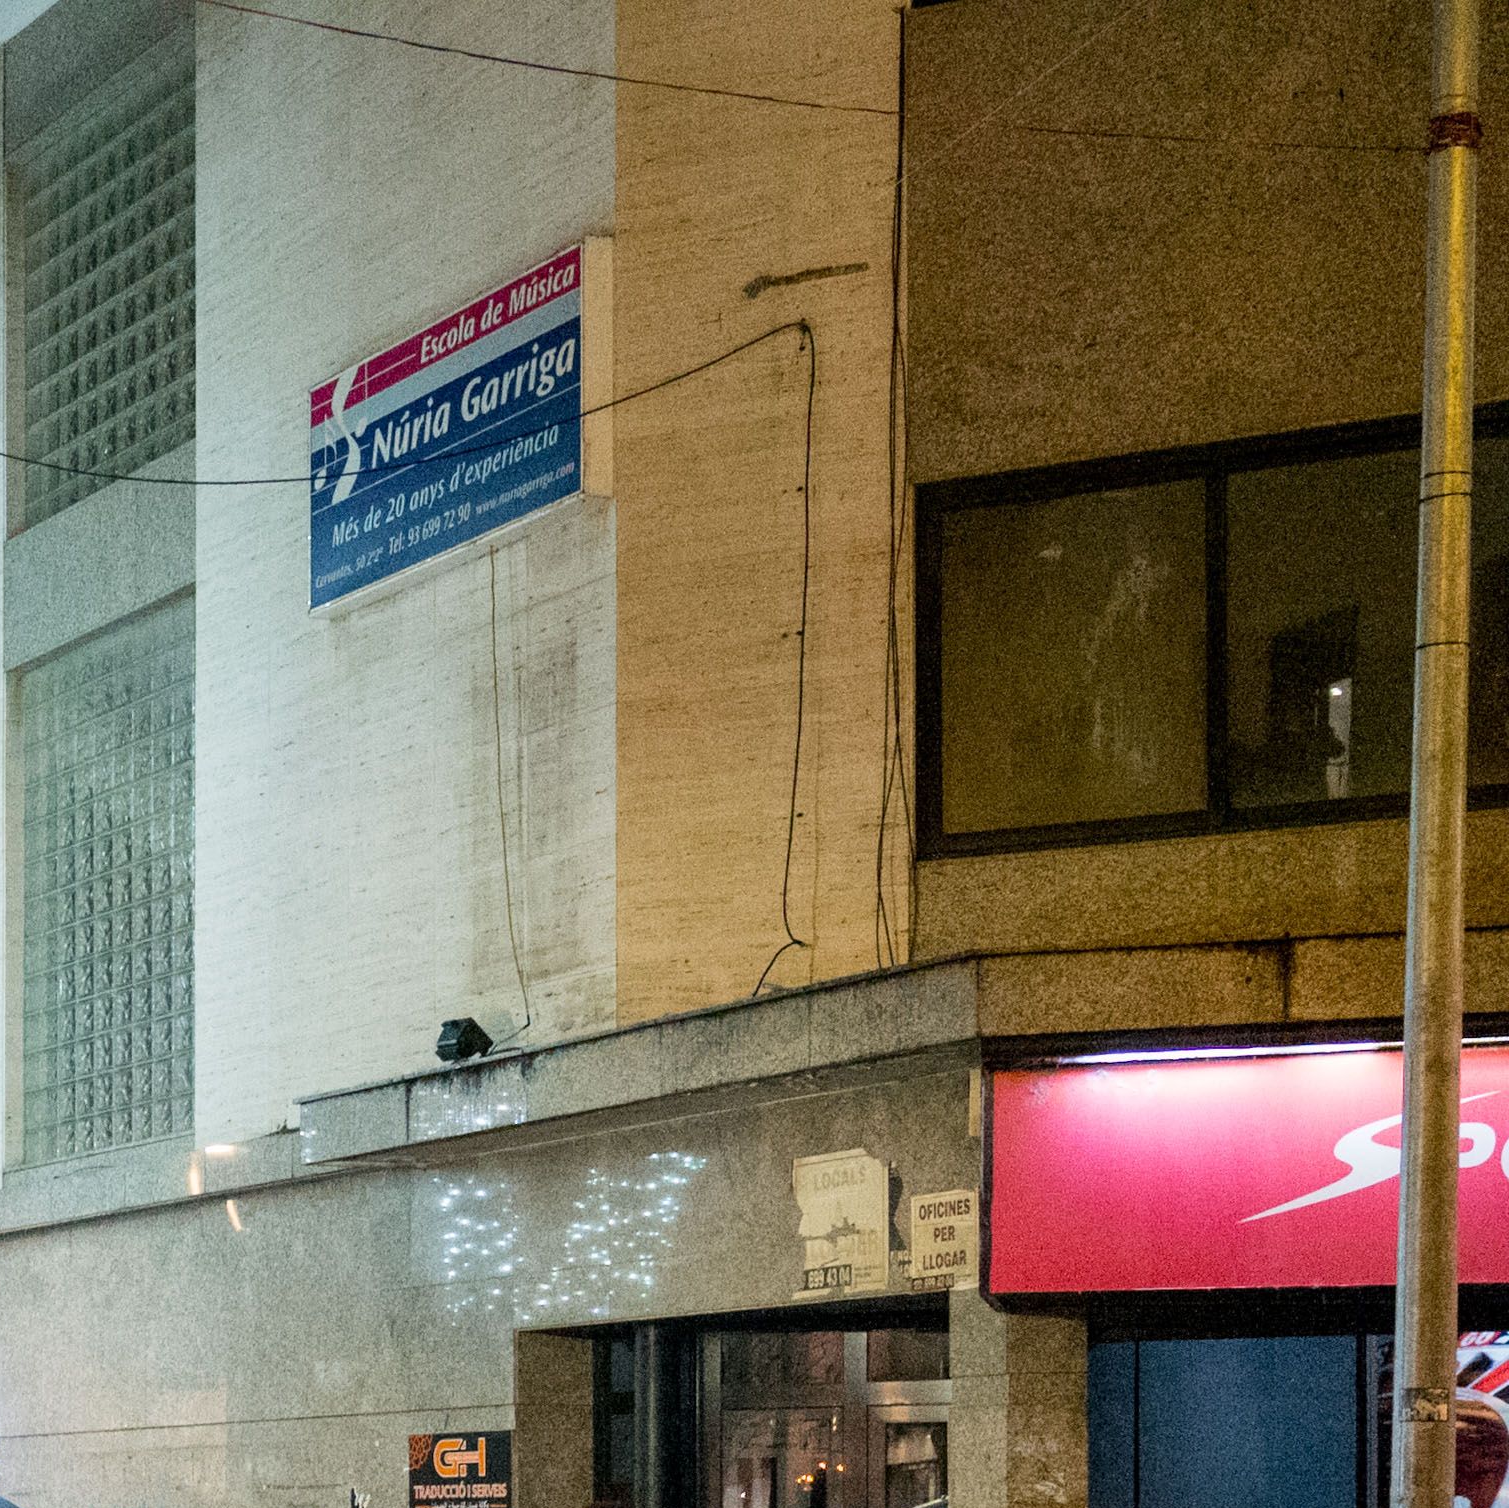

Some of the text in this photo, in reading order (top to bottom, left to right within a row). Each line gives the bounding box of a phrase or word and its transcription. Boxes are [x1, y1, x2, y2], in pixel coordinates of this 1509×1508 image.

[420, 263, 576, 363] Escola de Música
[371, 337, 576, 469] Núria Garriga
[332, 516, 359, 548] Més
[363, 505, 382, 533] de
[385, 493, 406, 523] 20
[409, 478, 445, 512] anys
[407, 524, 421, 548] 93
[422, 515, 441, 541] 699
[443, 508, 456, 531] 72
[457, 502, 471, 525] 90
[919, 1198, 971, 1221] OFICINES
[933, 1225, 956, 1243] PER
[922, 1250, 967, 1271] LLOGAR
[413, 1481, 466, 1499] TRADUCCIÓ
[472, 1483, 508, 1498] SERVEIS
